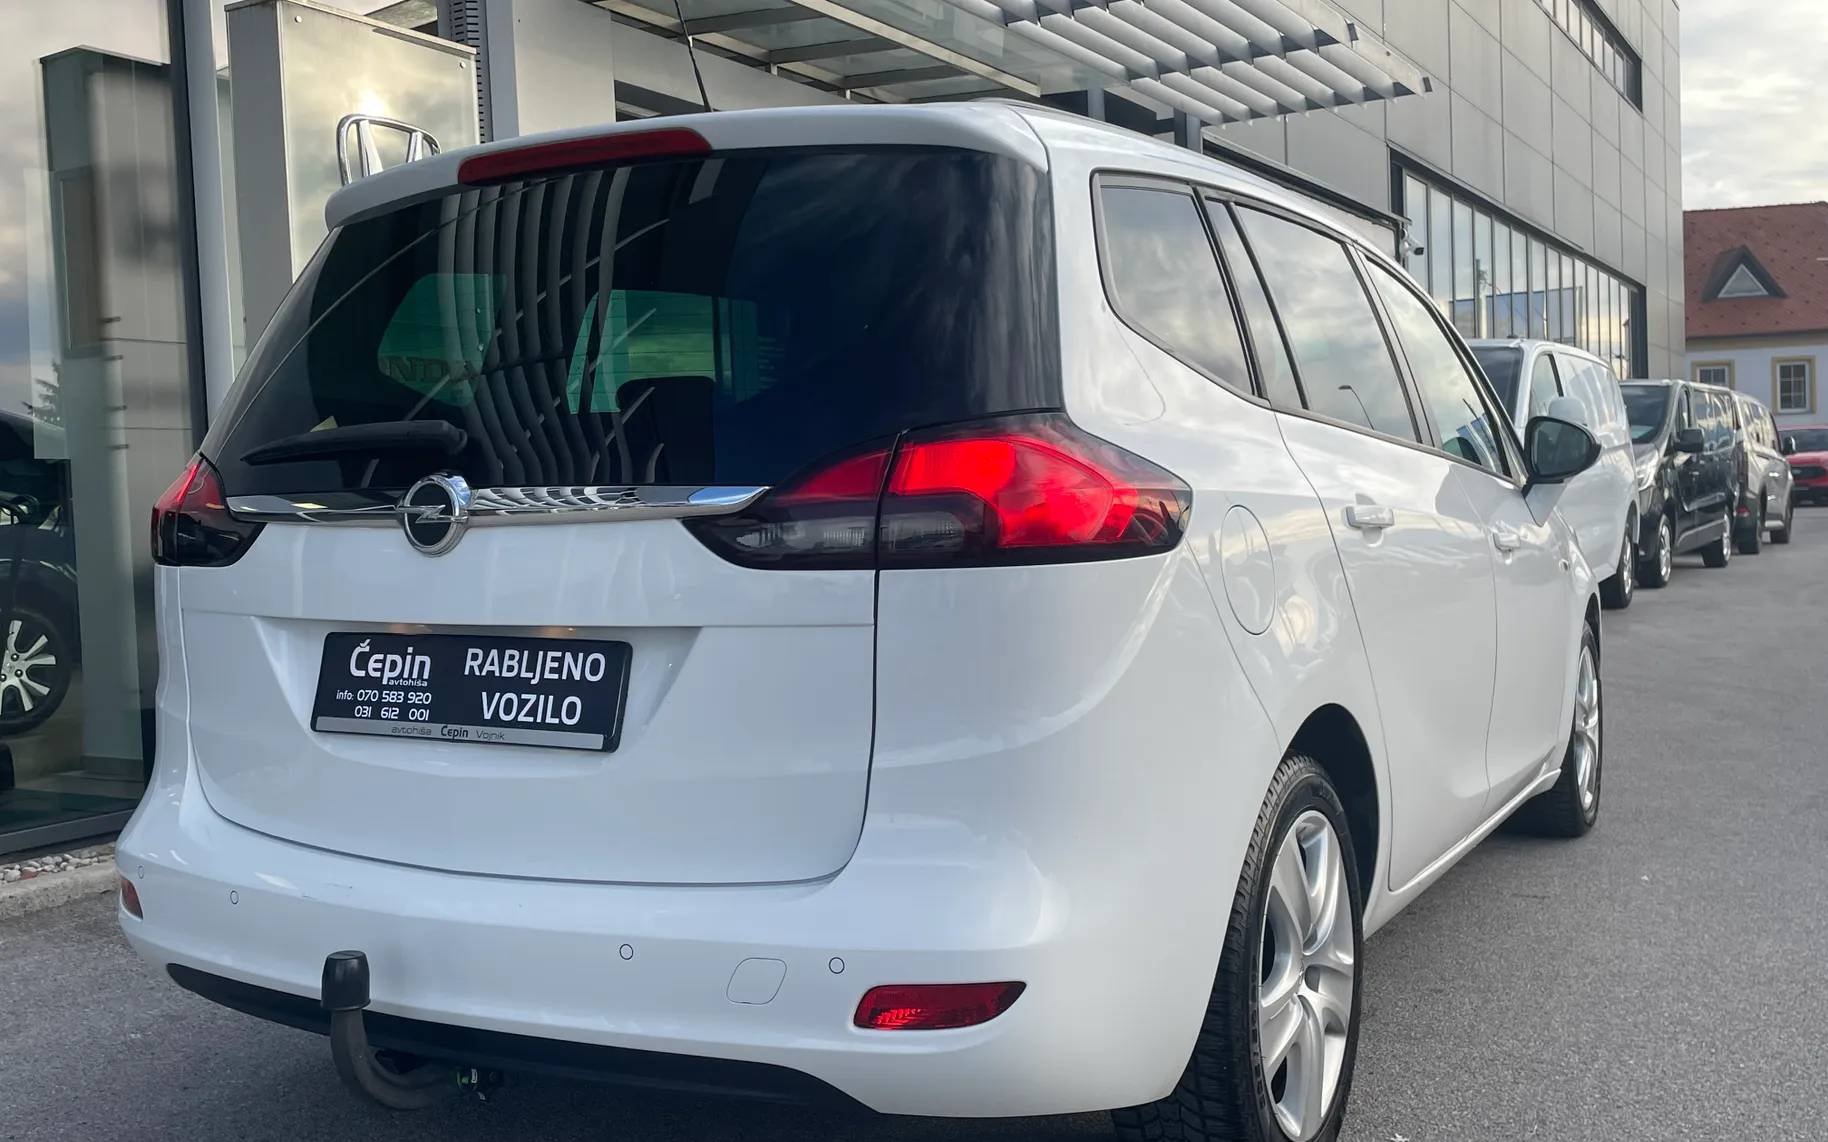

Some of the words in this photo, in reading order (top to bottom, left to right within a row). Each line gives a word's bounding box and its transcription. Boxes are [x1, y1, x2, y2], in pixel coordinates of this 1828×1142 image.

[464, 647, 606, 685] RABLJENO
[336, 689, 354, 701] info:
[356, 689, 379, 702] 070
[381, 690, 404, 703] 583
[407, 691, 432, 705] 920
[354, 705, 372, 718] 031
[380, 707, 400, 719] 612
[408, 708, 430, 721] 001
[481, 691, 582, 726] VOZILO
[475, 729, 506, 741] Vojnik
